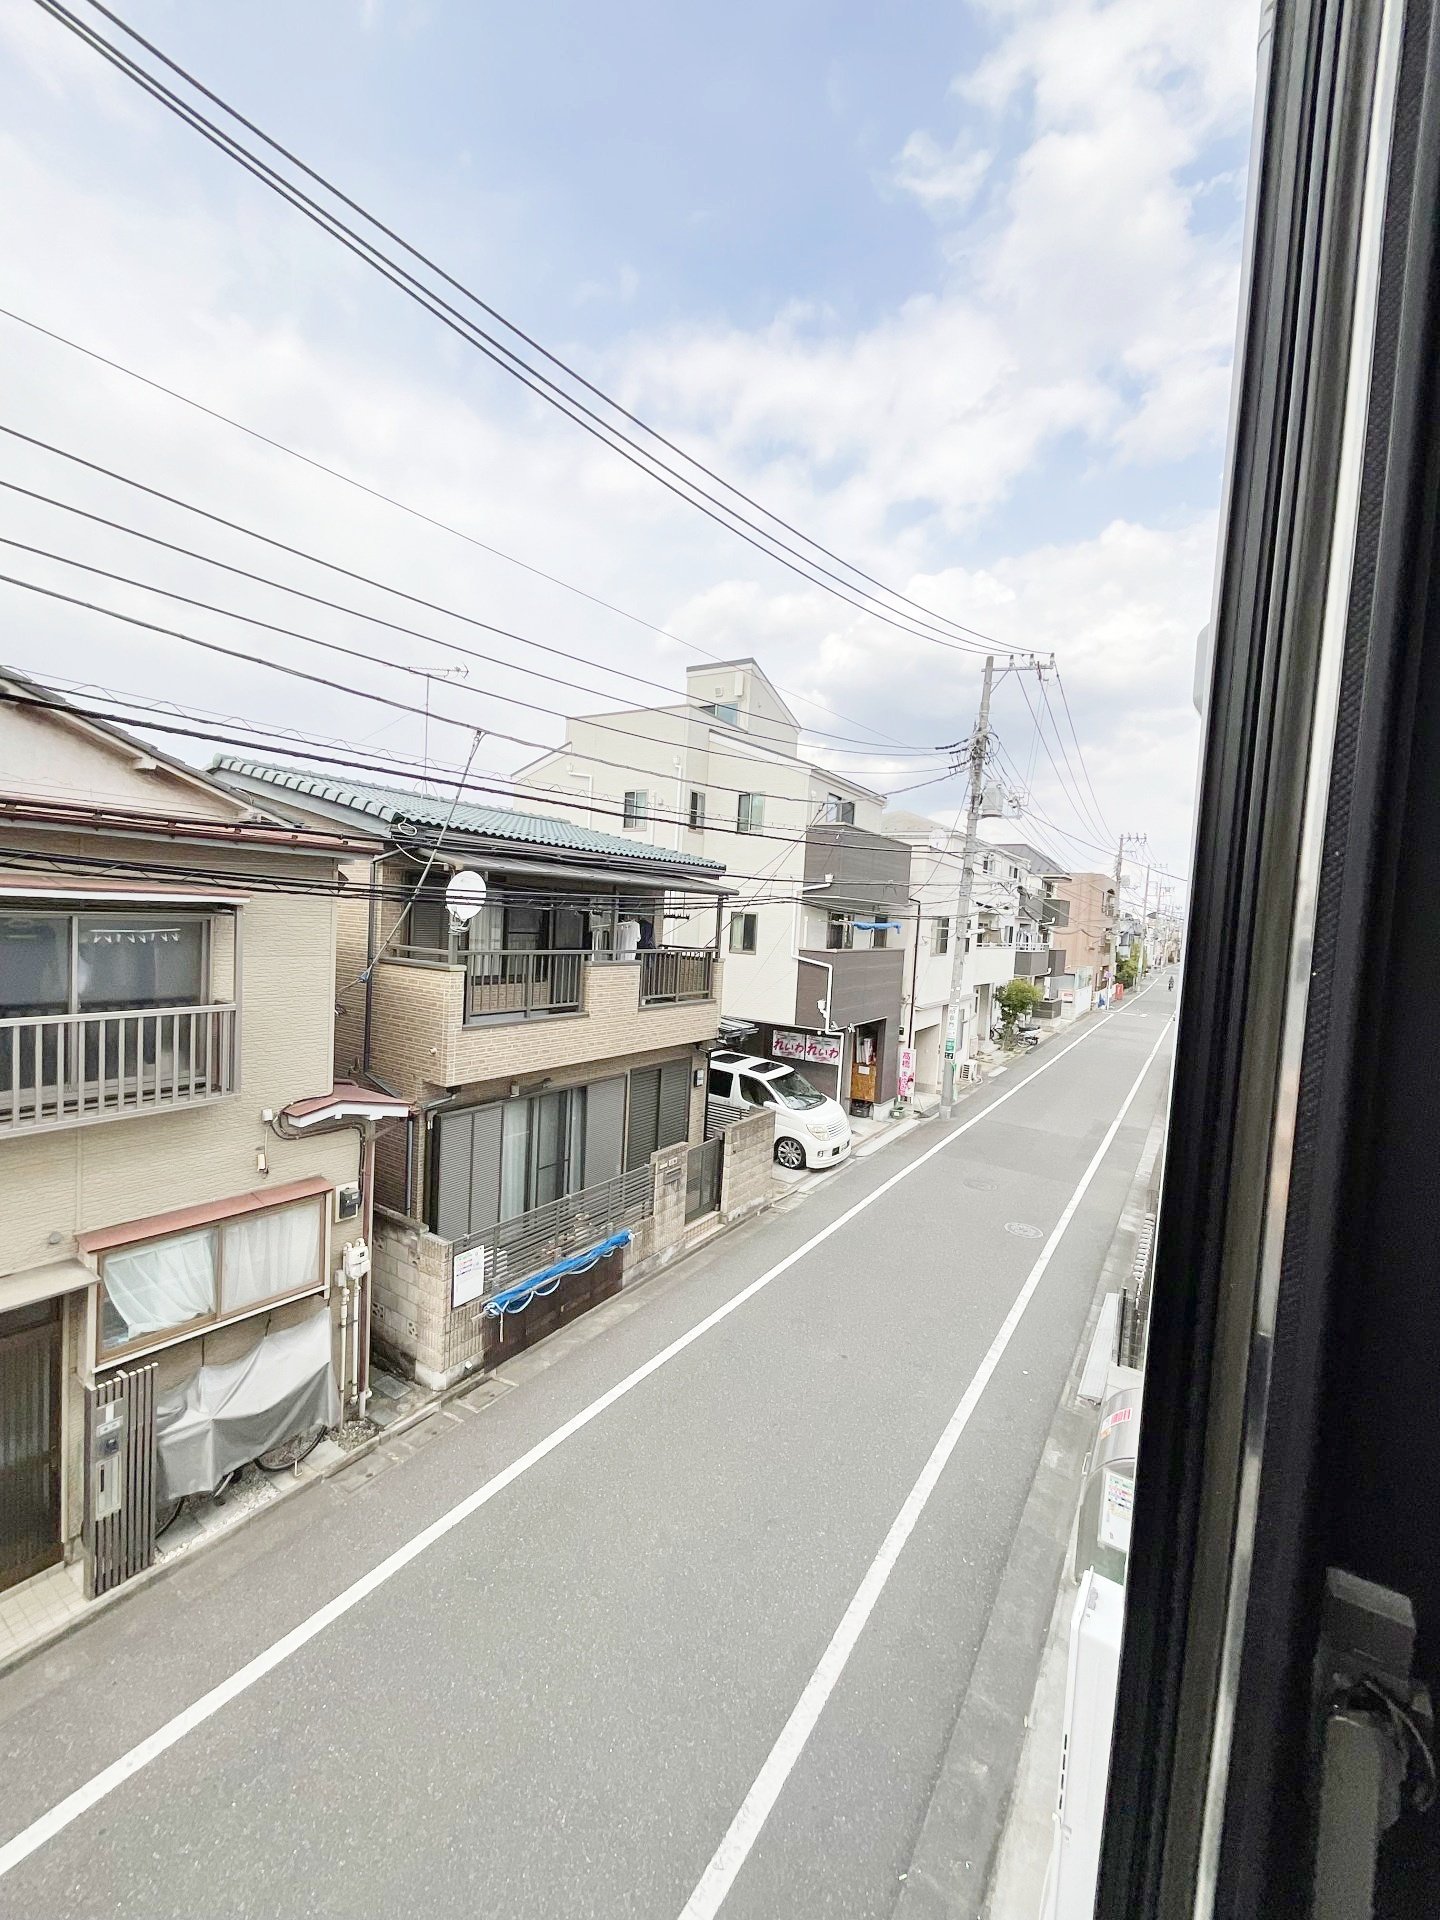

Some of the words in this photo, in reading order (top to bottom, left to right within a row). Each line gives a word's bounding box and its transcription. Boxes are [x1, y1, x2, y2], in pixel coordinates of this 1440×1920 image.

[774, 1039, 804, 1054] れいわ
[807, 1043, 839, 1058] れいわ
